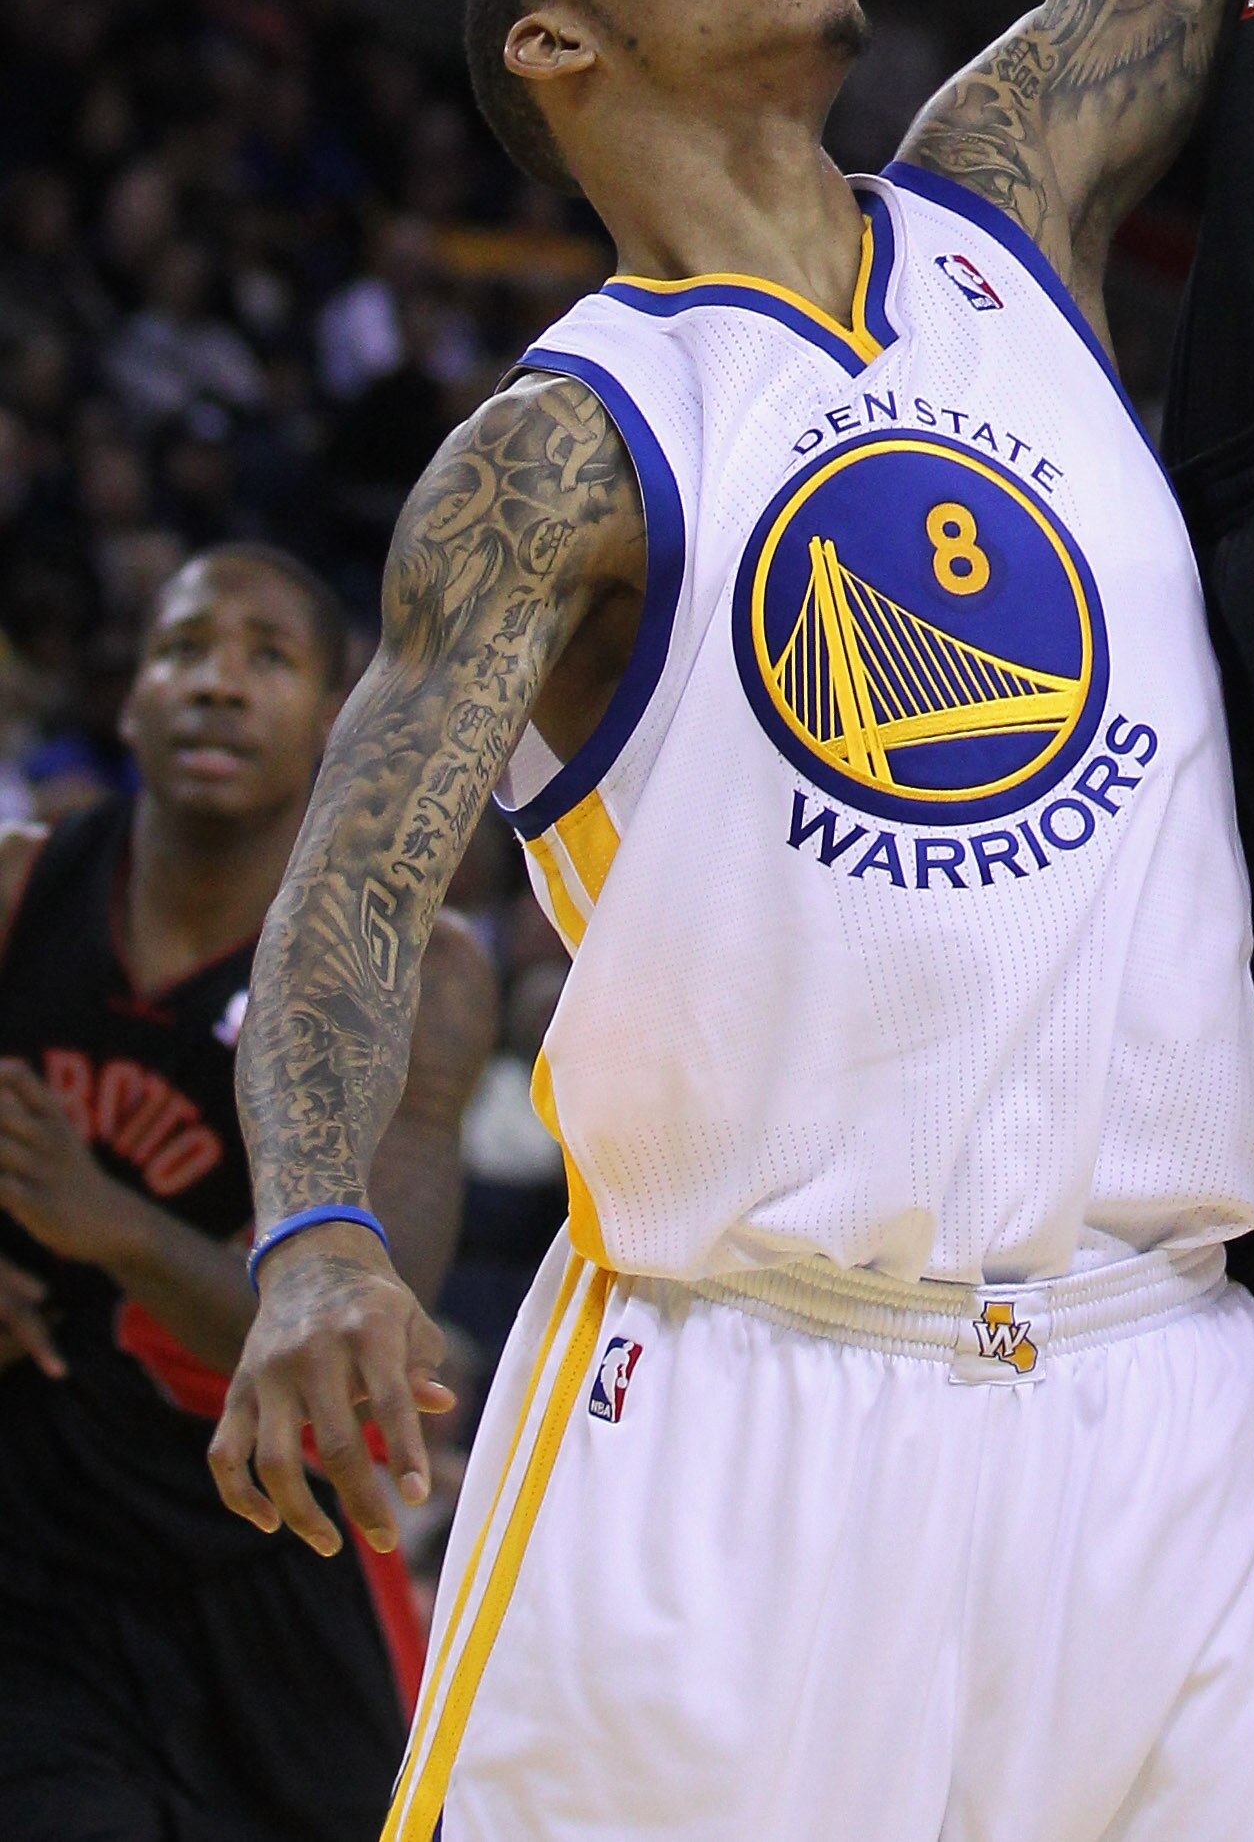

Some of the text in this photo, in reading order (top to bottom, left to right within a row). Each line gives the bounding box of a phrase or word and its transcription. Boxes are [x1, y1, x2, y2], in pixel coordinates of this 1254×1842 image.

[791, 390, 1064, 494] DEN STATE
[926, 502, 991, 596] 8
[786, 713, 1159, 890] WARRIORS
[972, 1321, 1032, 1358] W
